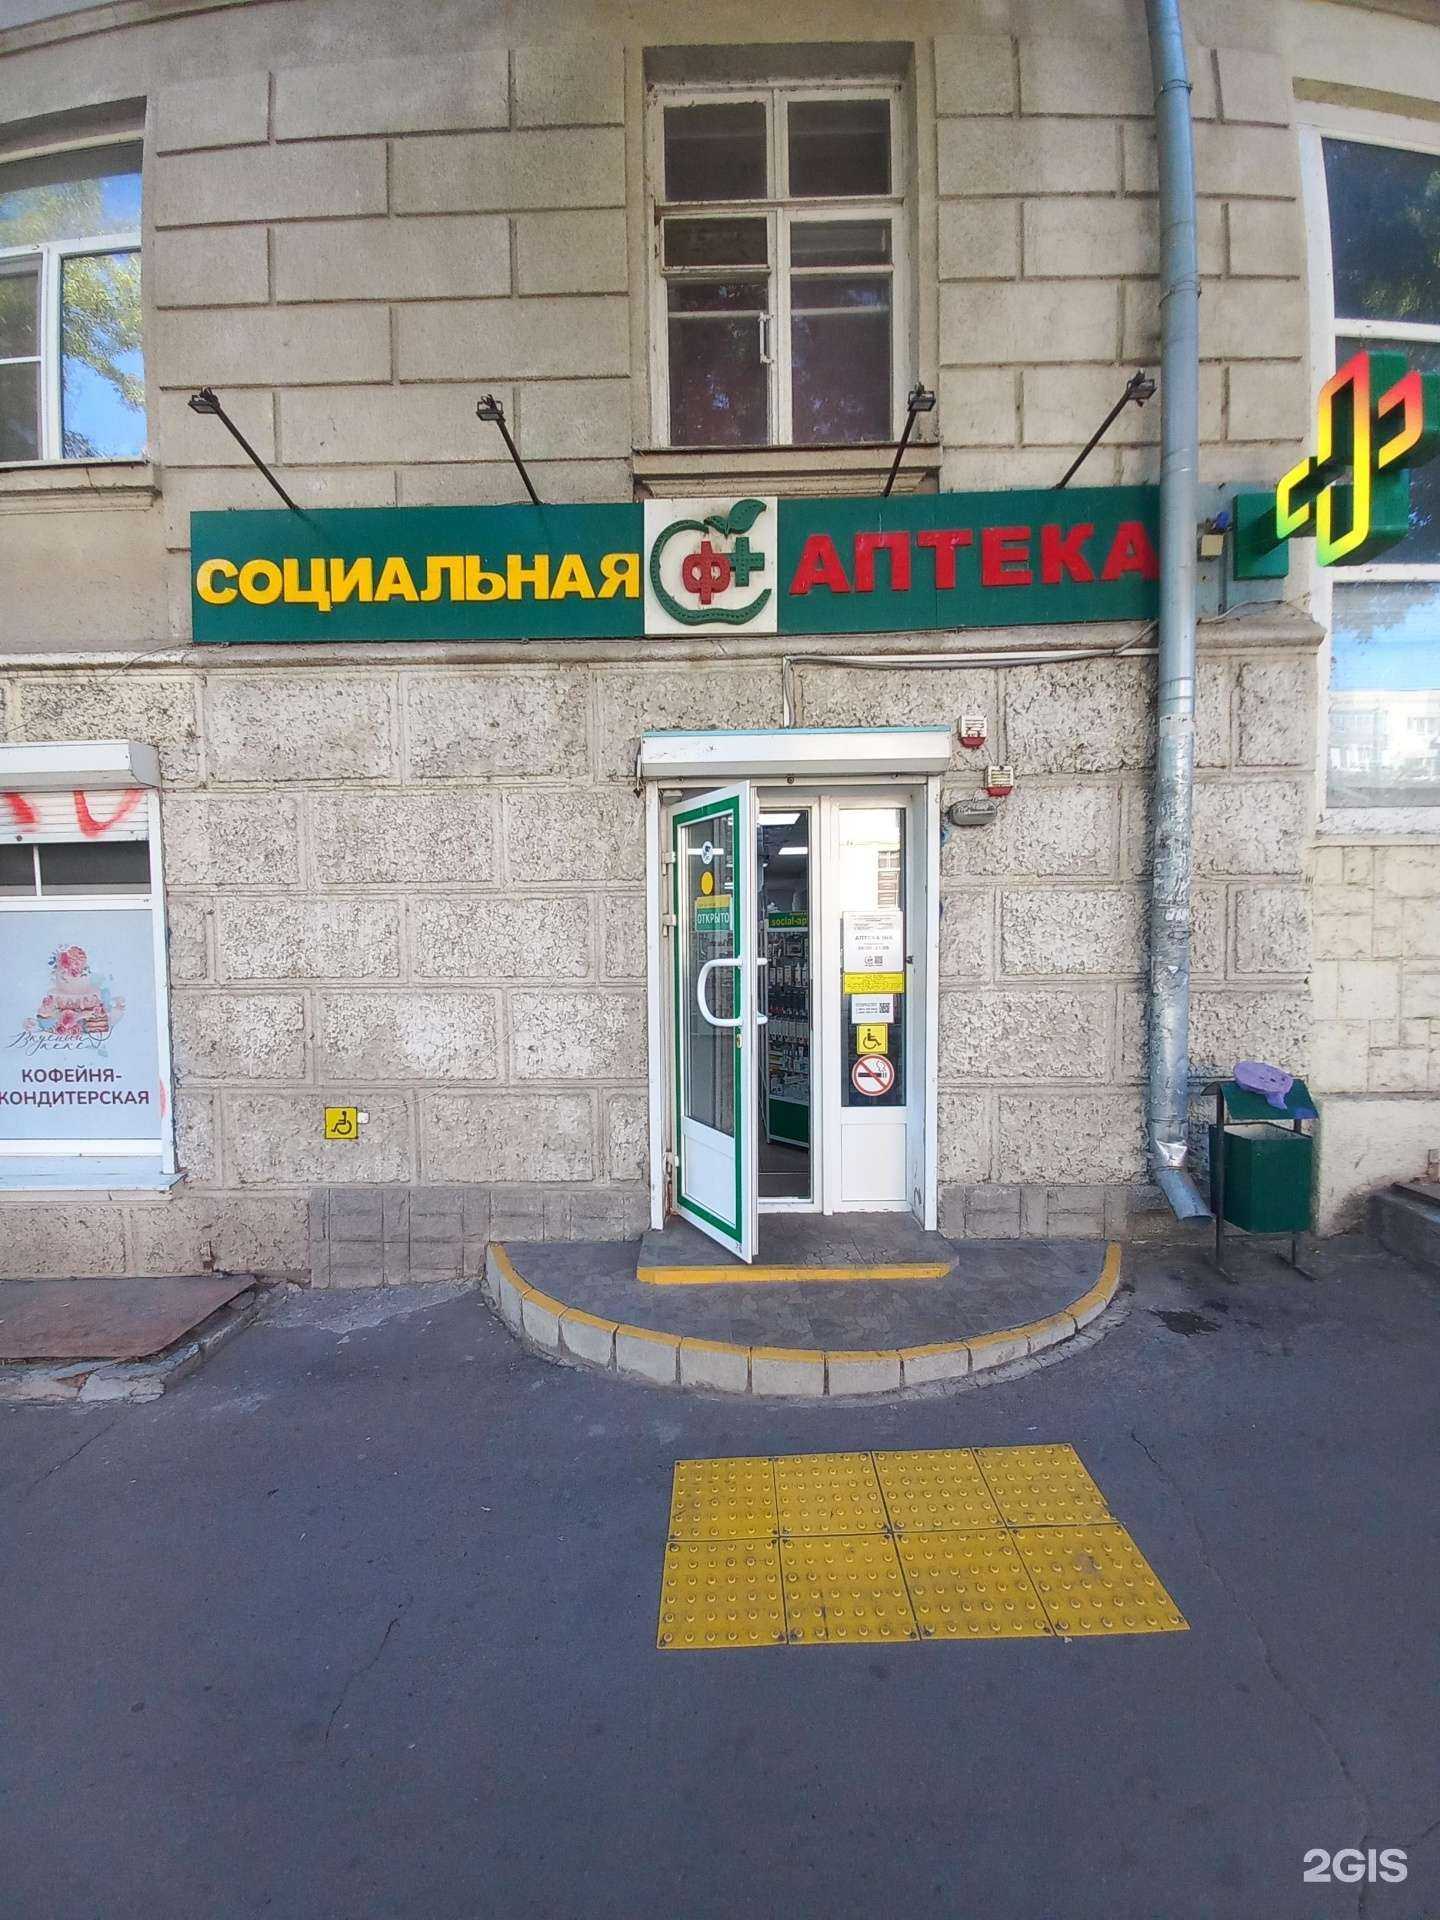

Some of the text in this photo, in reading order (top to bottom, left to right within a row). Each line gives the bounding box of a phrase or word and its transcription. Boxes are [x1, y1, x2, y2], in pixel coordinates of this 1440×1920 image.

[196, 520, 1160, 612] СОЦИАЛЬНАЯ АПТЕКА
[697, 911, 730, 924] ОТКРЫТО
[22, 1064, 122, 1083] КОФЕЙНЯ-
[0, 1090, 149, 1108] КОНДИТЕРСКАЯ
